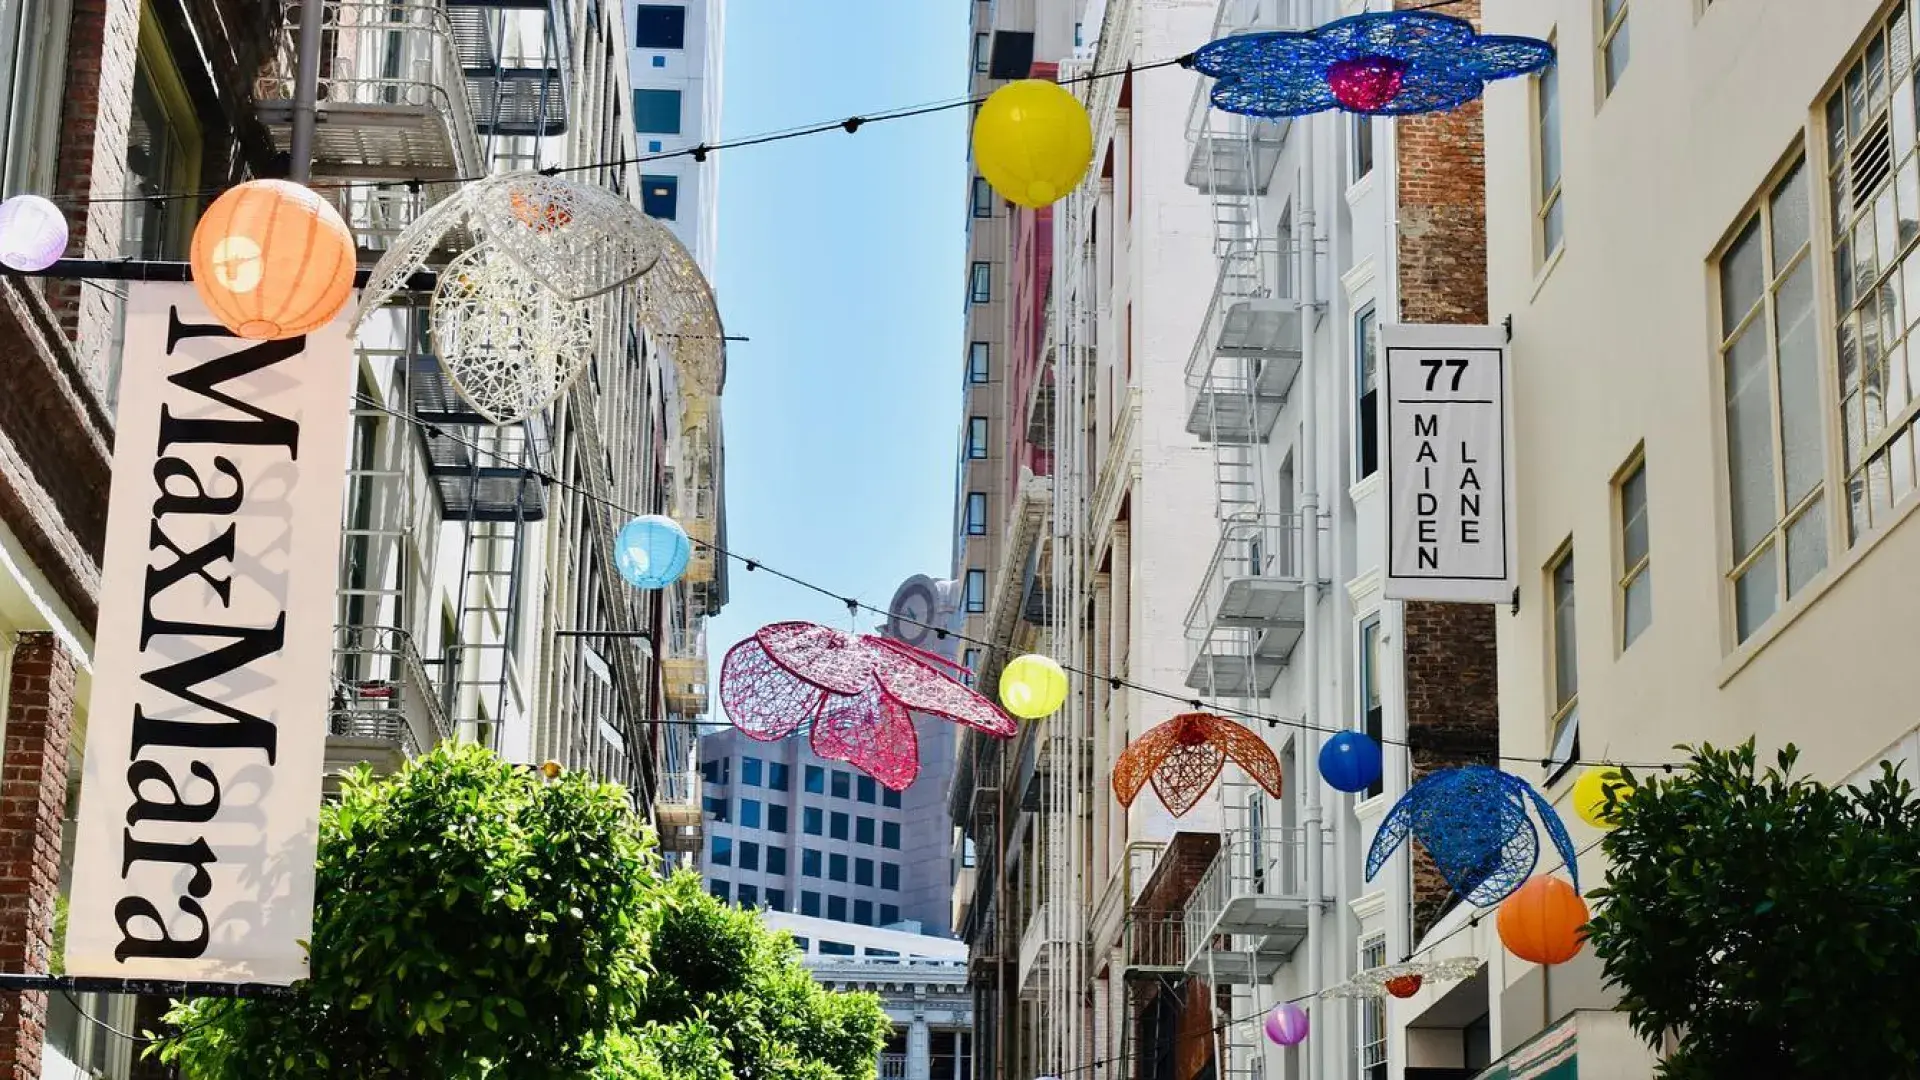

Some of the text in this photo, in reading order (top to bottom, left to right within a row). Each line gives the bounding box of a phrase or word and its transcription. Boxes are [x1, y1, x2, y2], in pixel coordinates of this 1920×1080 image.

[1419, 359, 1470, 392] 77
[1414, 413, 1439, 571] MAIDEN
[1460, 441, 1482, 544] LANE
[114, 304, 307, 965] MaxMara
